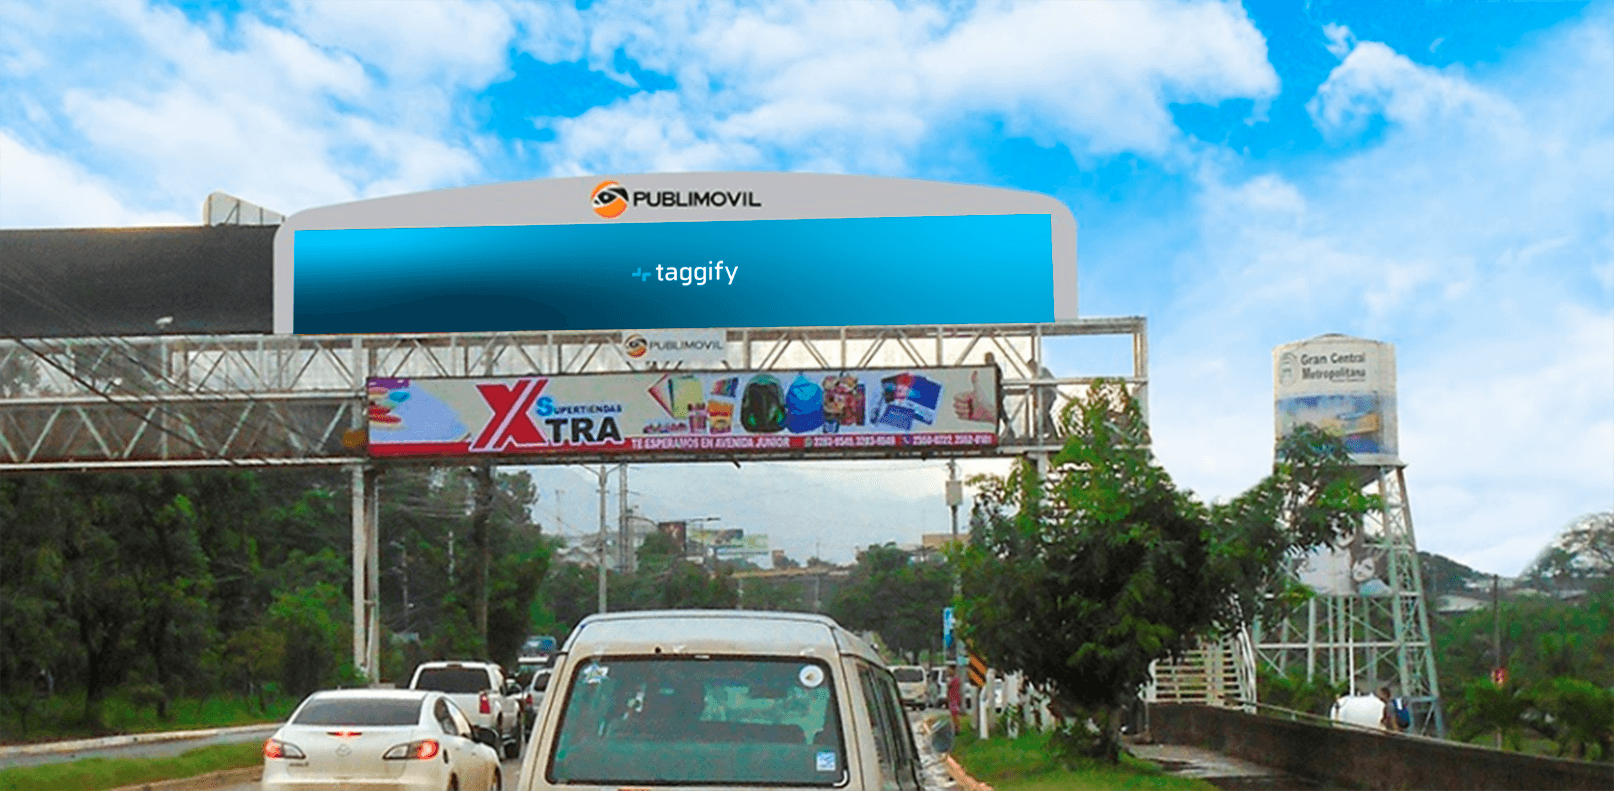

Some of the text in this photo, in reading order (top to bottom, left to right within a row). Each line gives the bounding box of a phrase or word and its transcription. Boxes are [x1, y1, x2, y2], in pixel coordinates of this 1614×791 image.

[633, 191, 761, 207] PUBLIMOVIL
[655, 260, 738, 285] taggify
[649, 340, 723, 350] PUBLIMOVIL
[1300, 352, 1365, 365] Gran Central
[1301, 367, 1365, 380] Metropolitana
[632, 438, 643, 449] TE
[645, 437, 699, 449] ESPERAMOS
[701, 437, 713, 449] EN
[715, 437, 754, 449] AVENIDA
